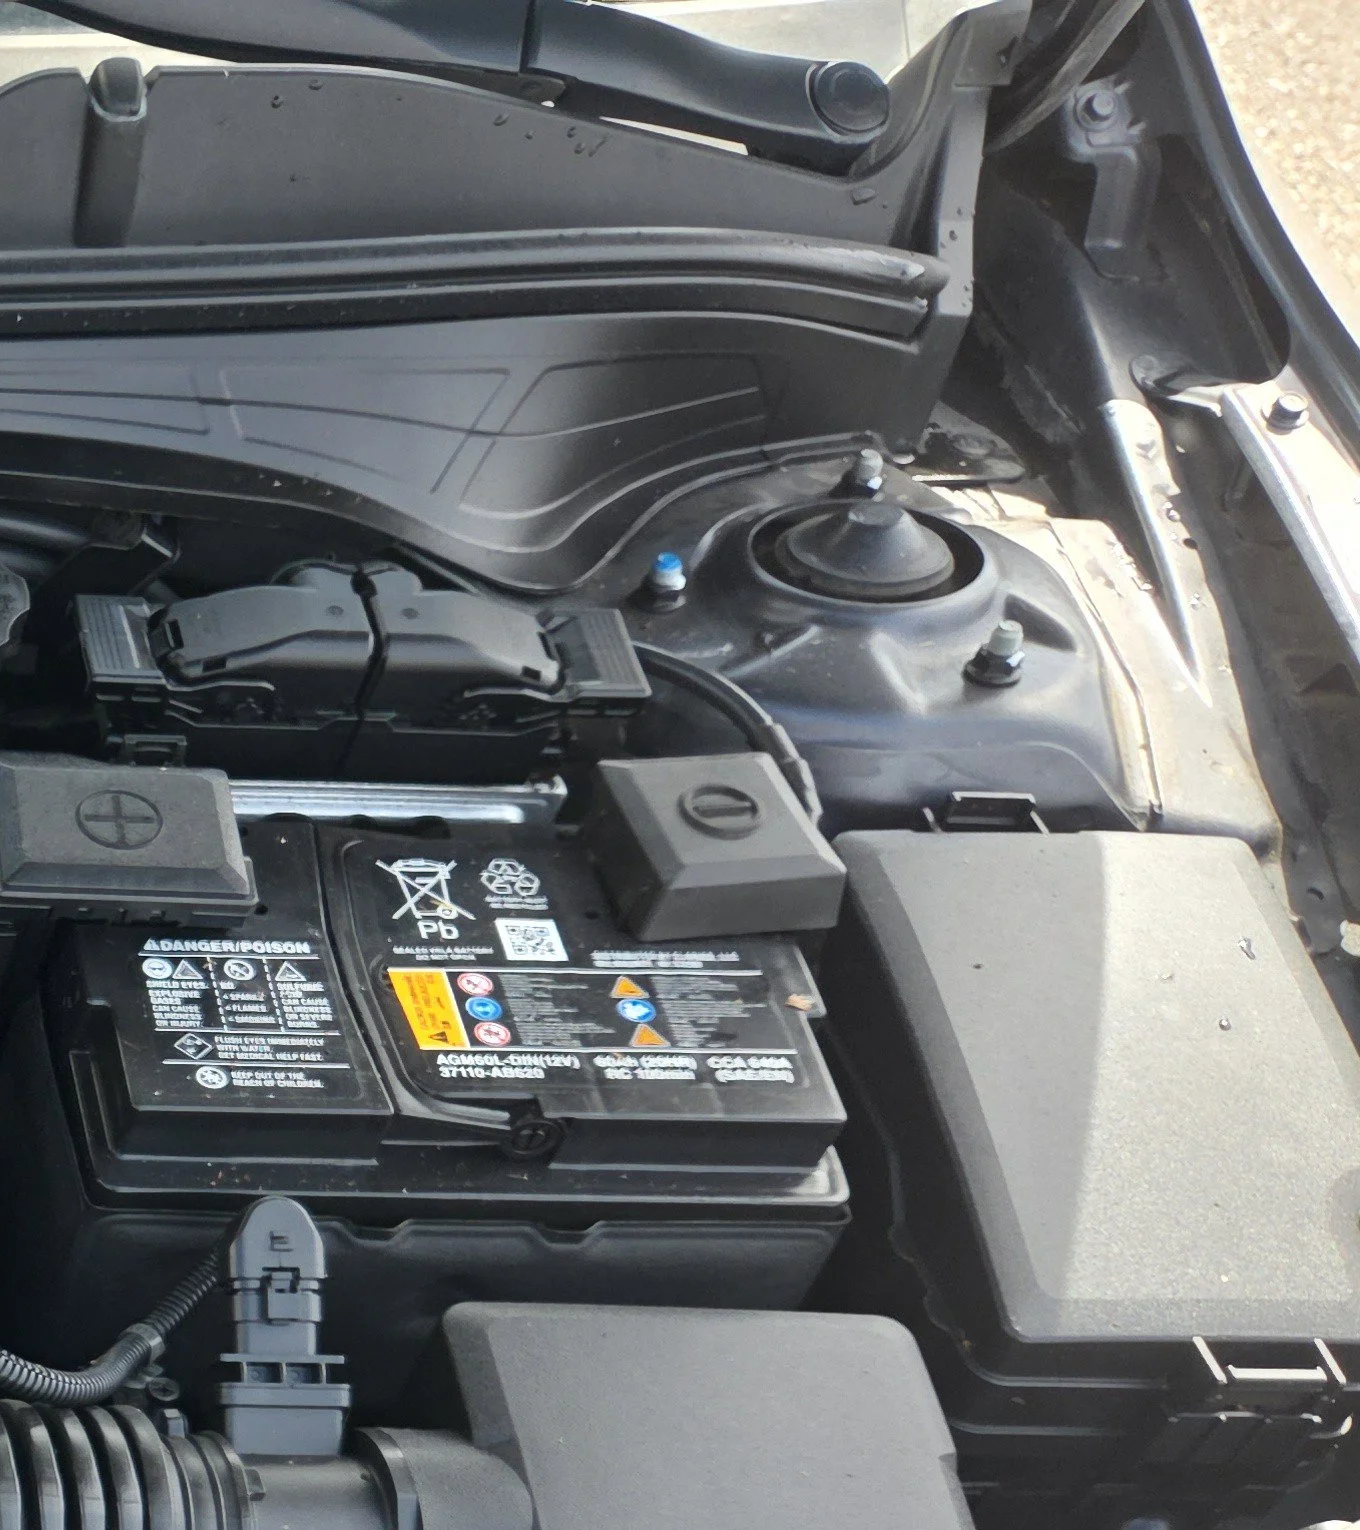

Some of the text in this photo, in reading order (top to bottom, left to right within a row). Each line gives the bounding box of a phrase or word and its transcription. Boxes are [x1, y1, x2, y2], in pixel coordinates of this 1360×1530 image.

[416, 919, 460, 940] Pb
[159, 938, 312, 955] DANGER/POISON
[214, 1036, 243, 1045] FLUSH
[244, 1037, 266, 1045] EYES
[216, 1044, 240, 1052] WITH
[276, 1052, 299, 1061] HELP
[230, 1071, 254, 1079] KEEP
[254, 1071, 273, 1080] OUT
[232, 1079, 263, 1087] REACH
